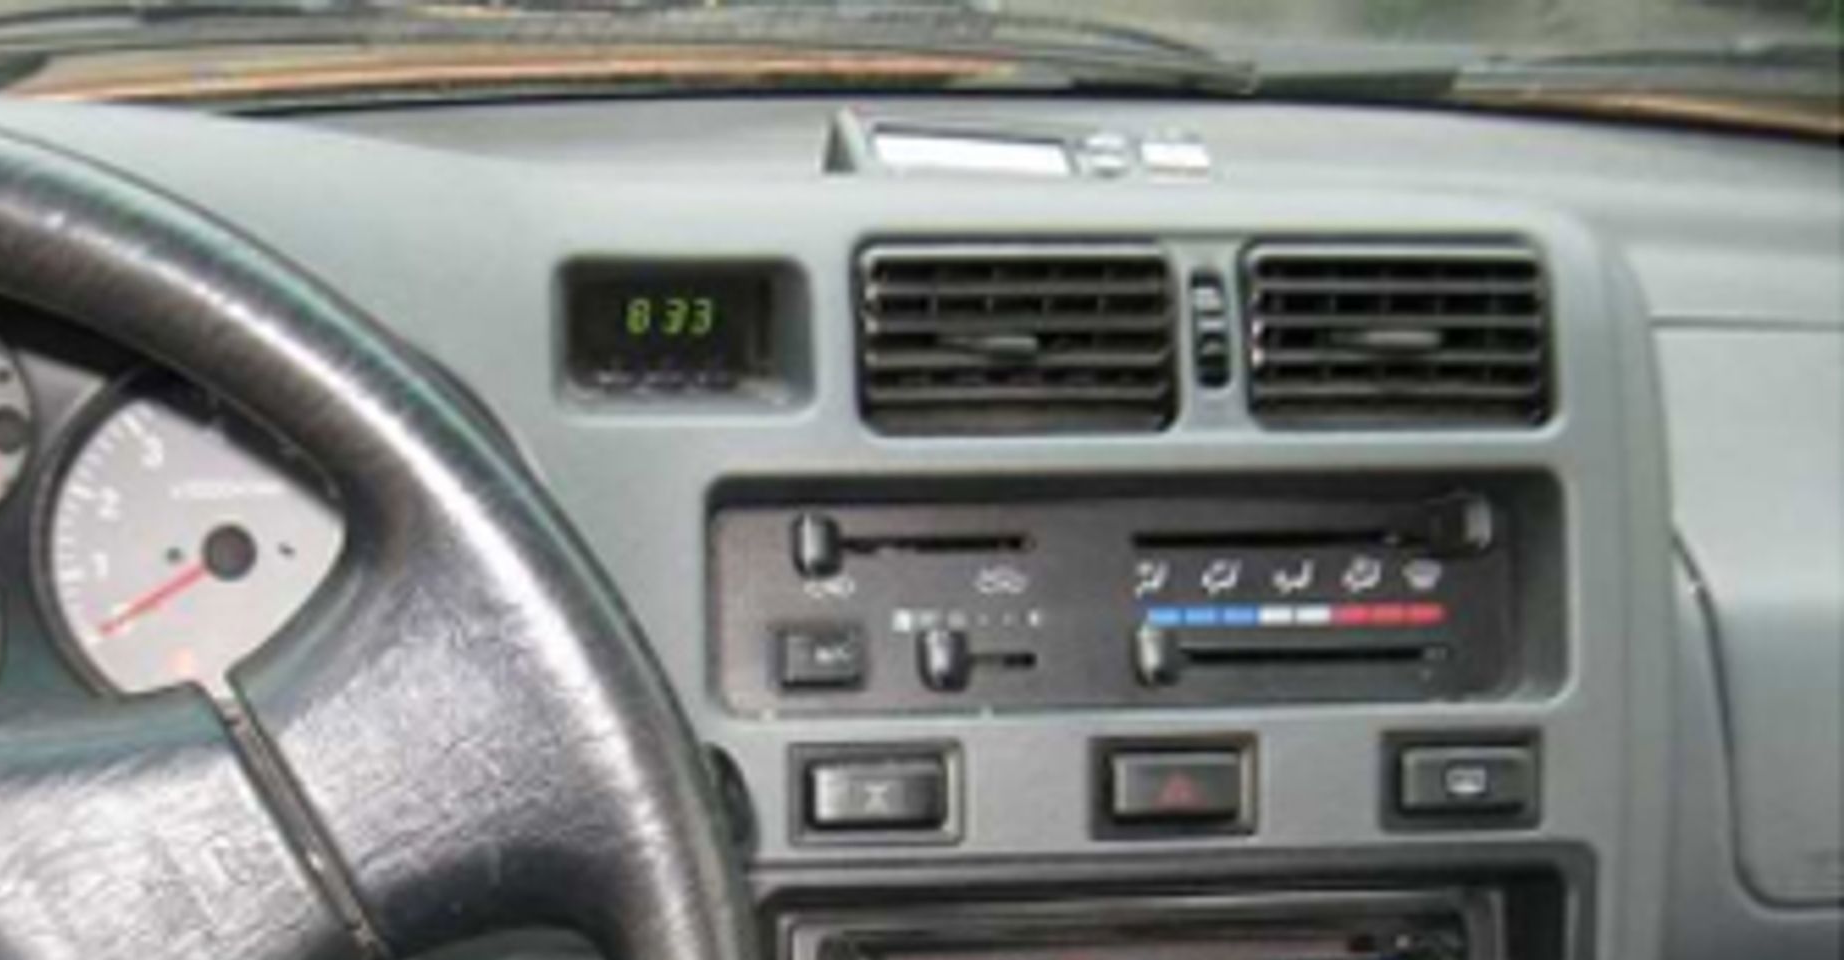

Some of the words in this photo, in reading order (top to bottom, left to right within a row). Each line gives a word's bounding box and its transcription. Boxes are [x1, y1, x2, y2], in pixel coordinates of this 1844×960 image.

[140, 435, 164, 468] 3
[99, 486, 120, 521] 2
[91, 551, 108, 580] 1
